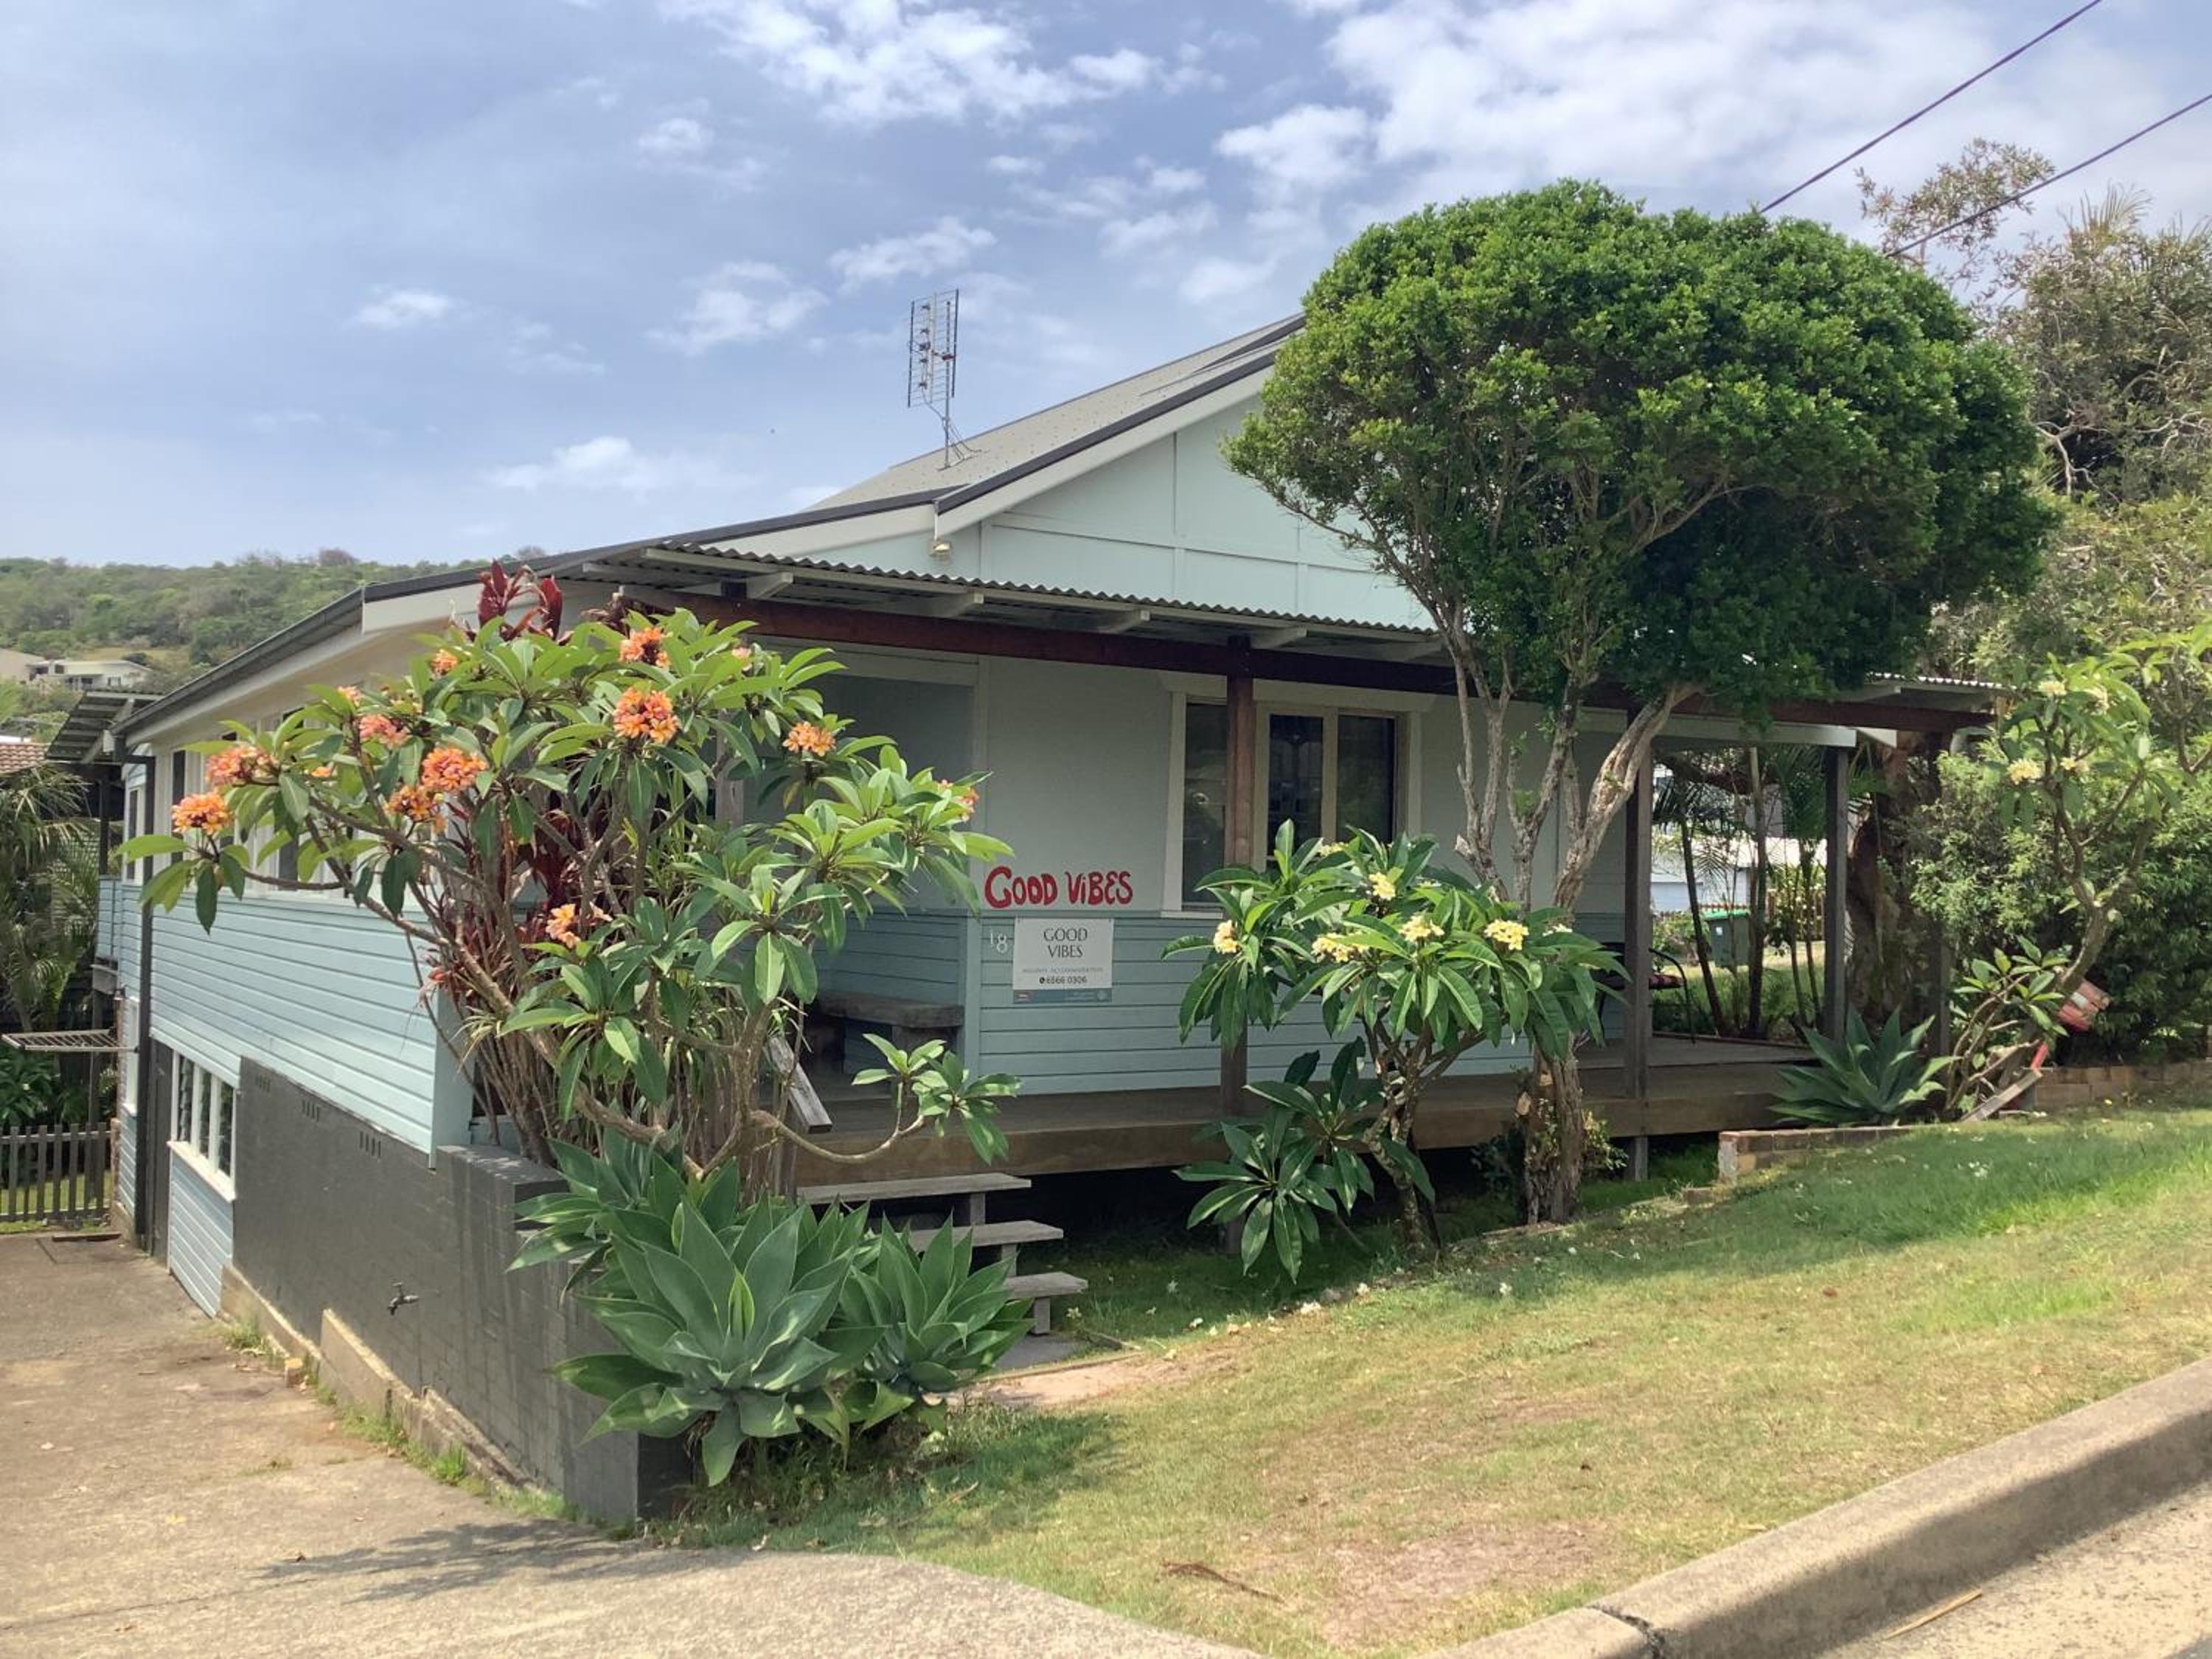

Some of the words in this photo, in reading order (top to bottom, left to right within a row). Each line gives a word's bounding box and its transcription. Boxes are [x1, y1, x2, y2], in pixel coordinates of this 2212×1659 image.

[984, 866, 1058, 908] GOOD
[990, 929, 1008, 953] 18
[1043, 928, 1088, 942] GOOD
[1048, 945, 1083, 958] VIBES
